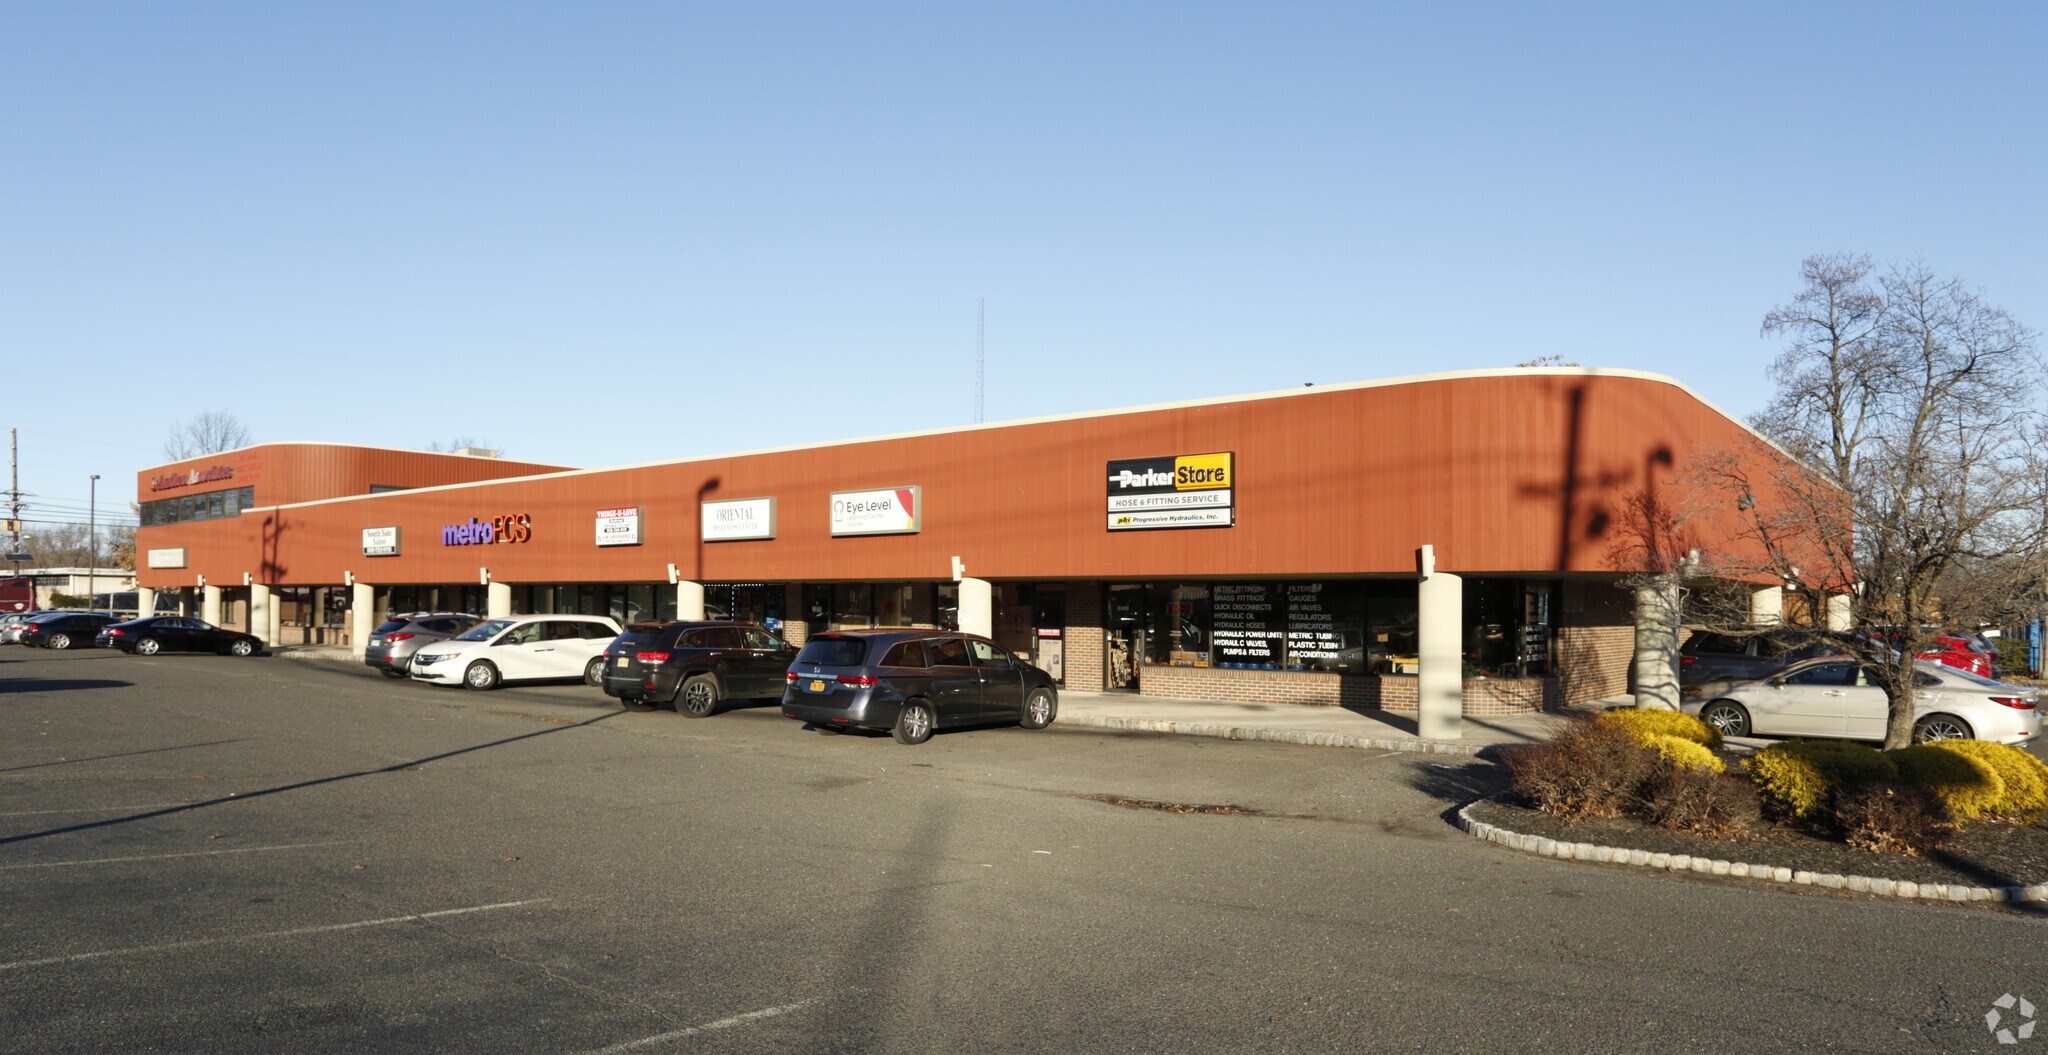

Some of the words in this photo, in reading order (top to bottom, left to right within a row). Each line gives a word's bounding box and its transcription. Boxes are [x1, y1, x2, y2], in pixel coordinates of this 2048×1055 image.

[1109, 468, 1175, 488] Parker
[1177, 465, 1225, 484] Store
[1115, 499, 1138, 507] HOSE
[1146, 496, 1180, 505] FITTING
[1181, 494, 1219, 503] SERVICE
[846, 501, 864, 515] Eye
[865, 498, 892, 512] Level
[716, 507, 755, 522] ORIENTAL
[1132, 515, 1168, 524] Progressive
[1169, 512, 1205, 522] Hydraulics,
[367, 529, 381, 537] South
[442, 513, 531, 546] metroPCS
[1233, 603, 1272, 611] DISCONNECTS
[1288, 613, 1332, 621] REGULATORS
[1288, 623, 1333, 631] LUBRICATORS
[1315, 632, 1340, 640] TUBING
[1214, 639, 1244, 647] HYDRAULC
[1288, 641, 1316, 649] PLASTIC
[1248, 649, 1270, 657] FILTERS
